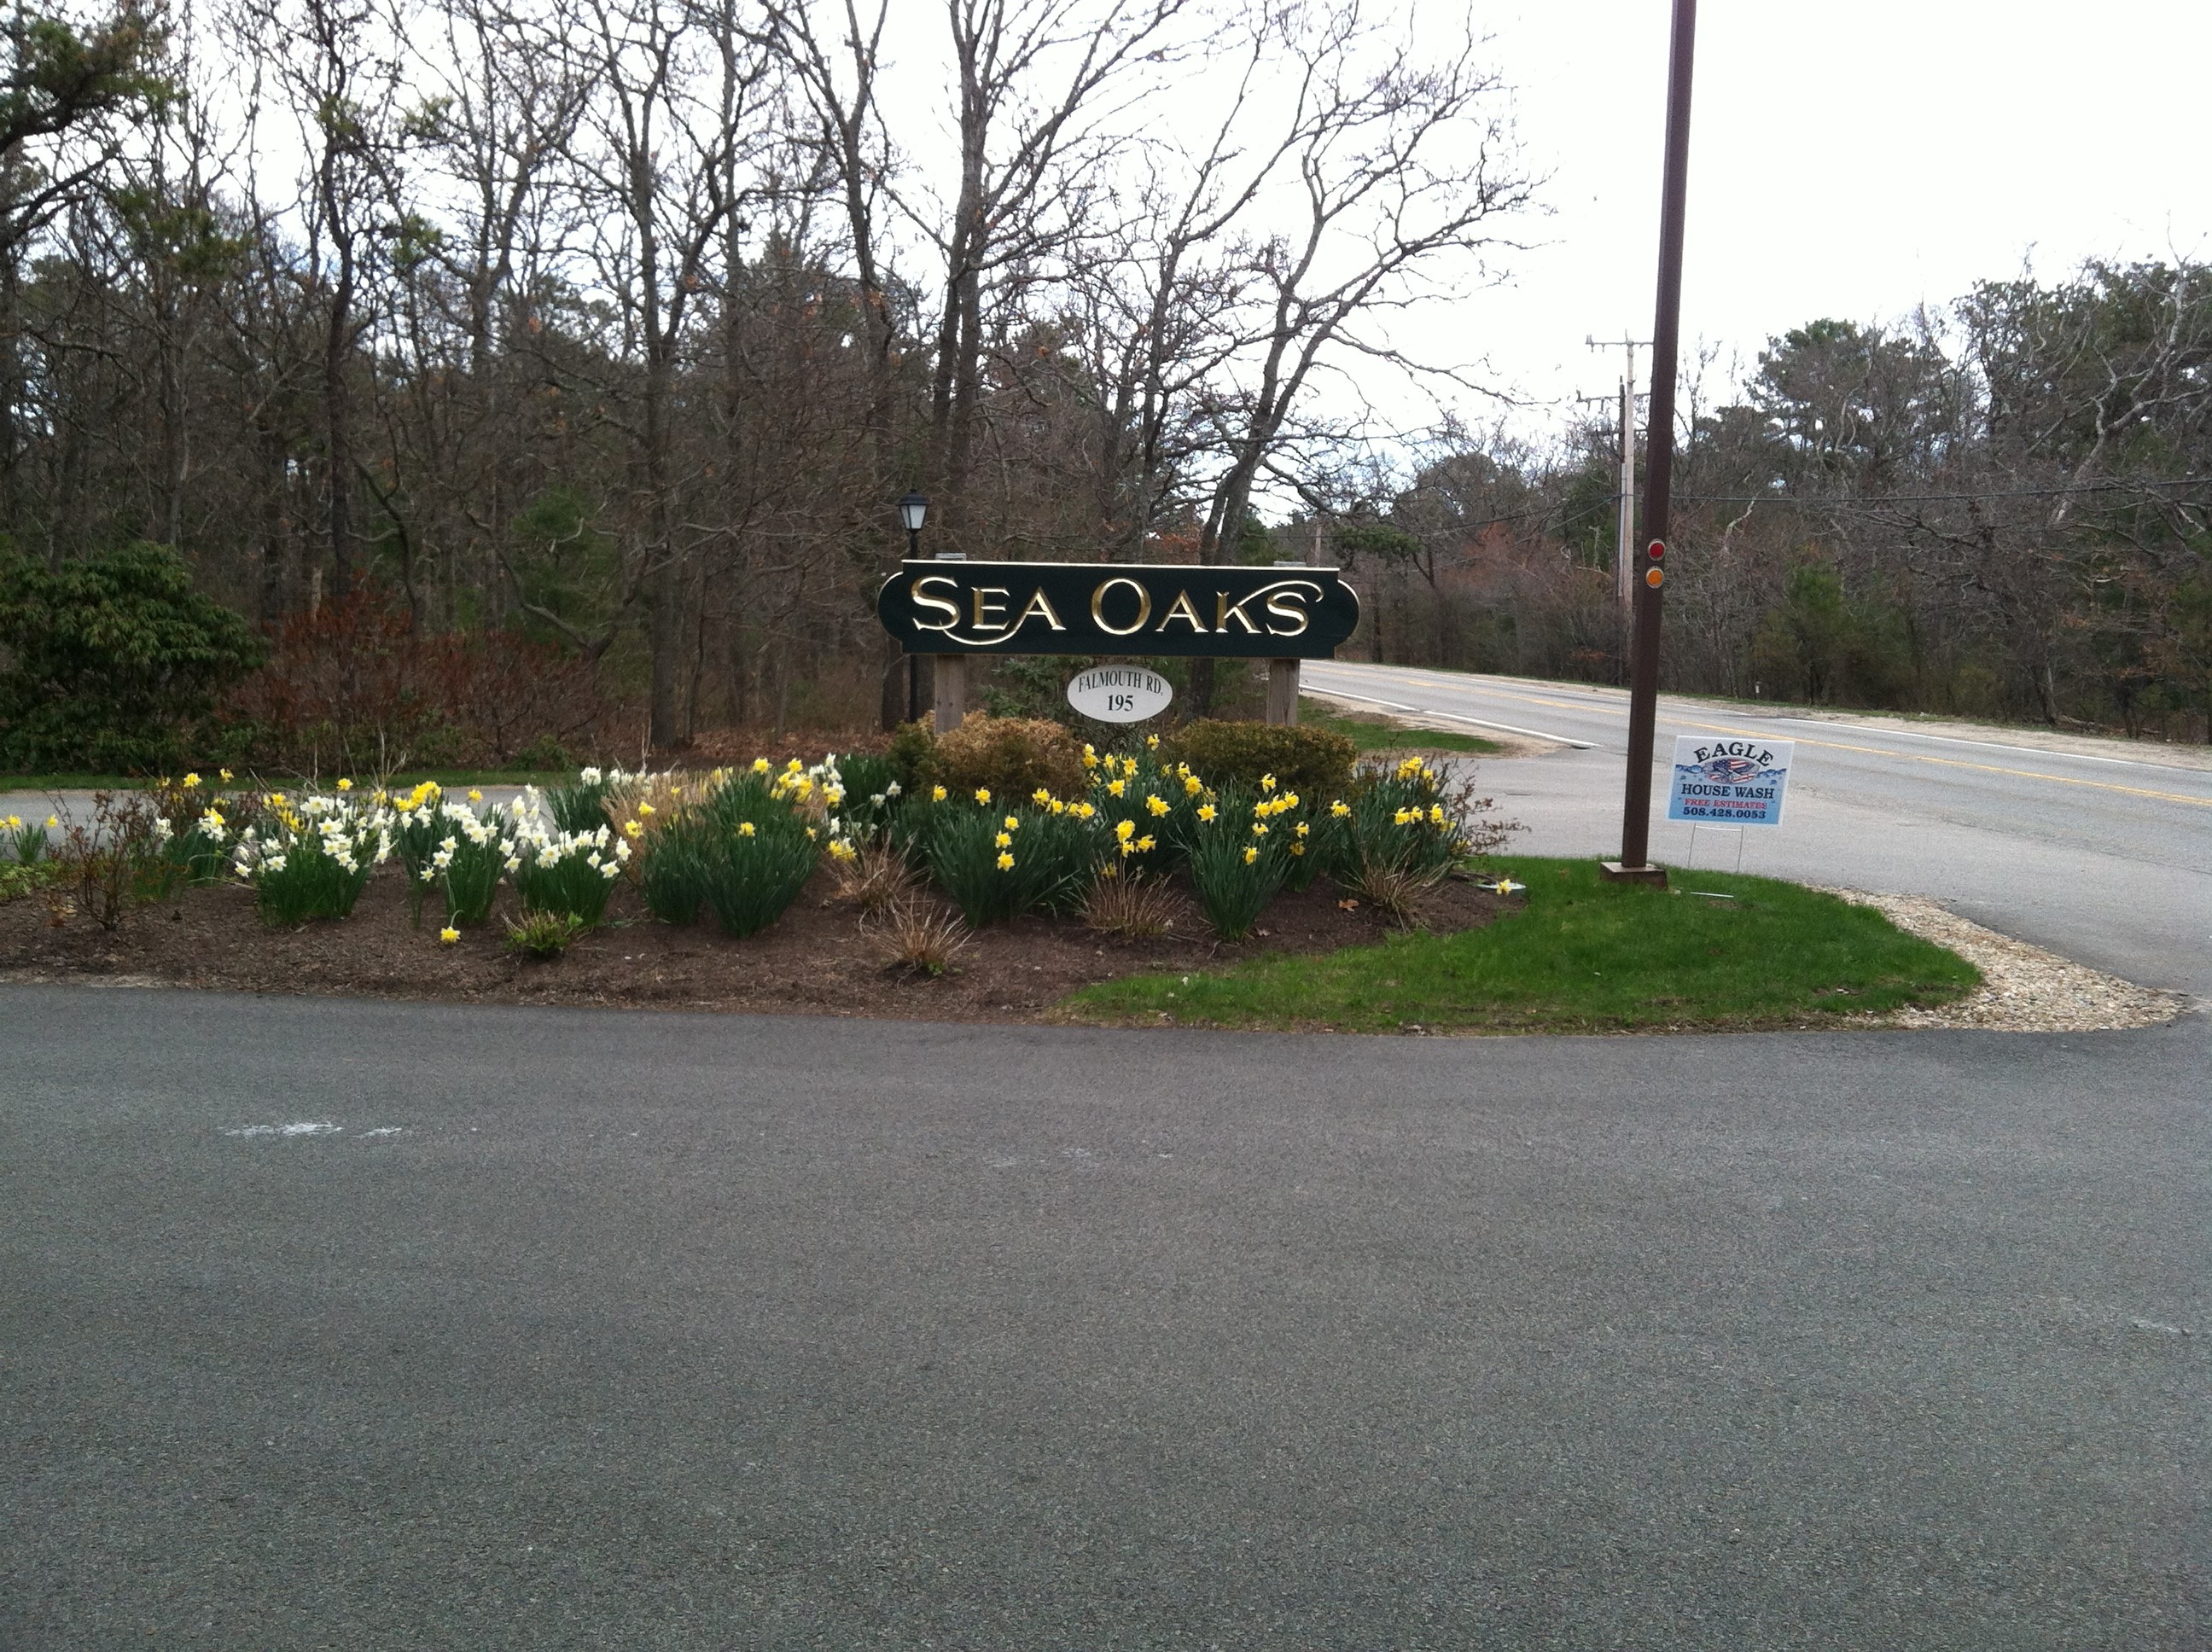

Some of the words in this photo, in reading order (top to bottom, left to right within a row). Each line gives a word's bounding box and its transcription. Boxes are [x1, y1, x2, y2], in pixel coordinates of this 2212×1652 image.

[911, 576, 1067, 646] SEA
[1091, 578, 1324, 637] OAKS
[1078, 670, 1142, 693] FALMOUTH
[1108, 694, 1134, 712] 195
[1693, 742, 1774, 767] EAGLE
[1681, 783, 1731, 797] HOUSE
[1735, 786, 1775, 800] WASH
[1682, 806, 1767, 819] 508.428.0053
[1684, 798, 1711, 806] FREE
[1713, 799, 1768, 810] ESTIMATES
